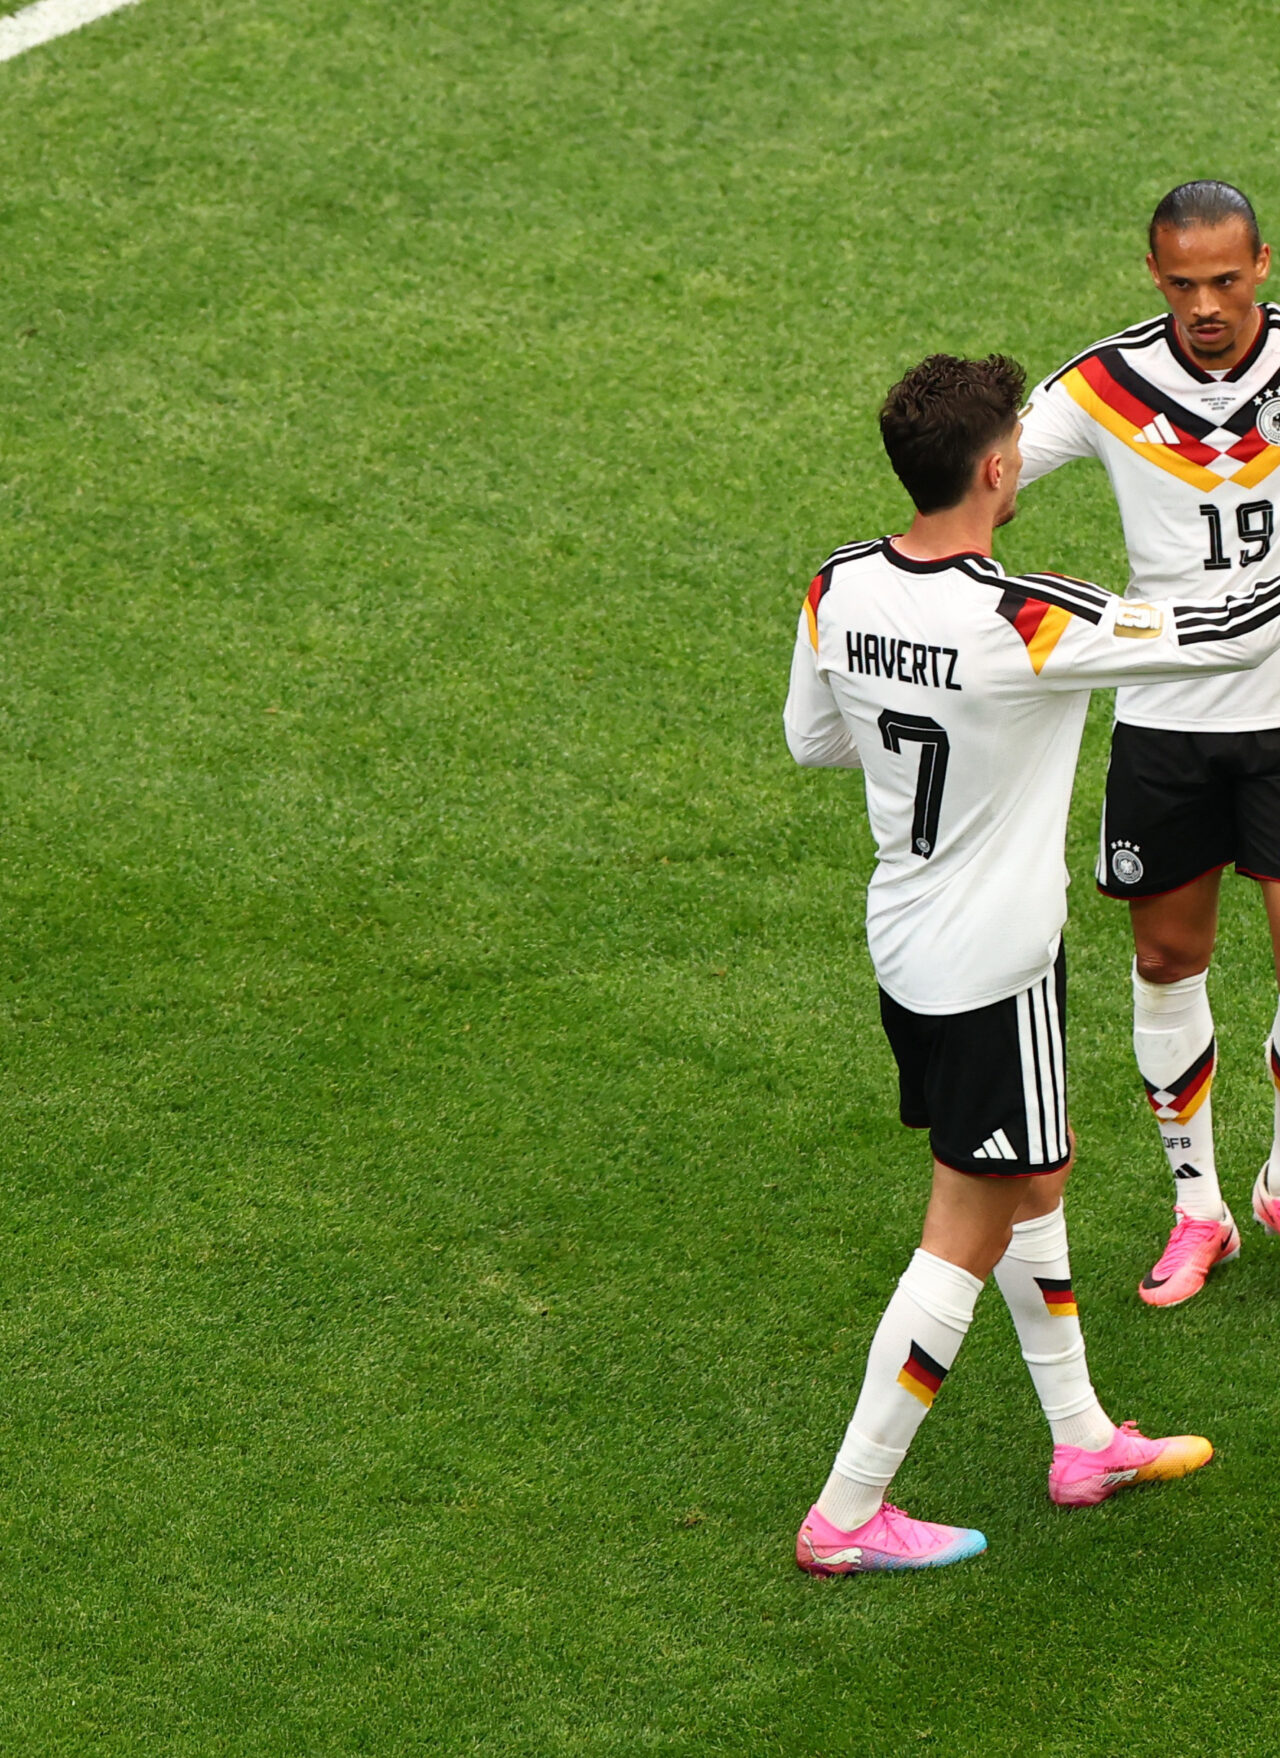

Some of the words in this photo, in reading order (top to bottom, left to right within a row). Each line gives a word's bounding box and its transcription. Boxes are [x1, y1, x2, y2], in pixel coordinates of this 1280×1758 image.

[1199, 499, 1274, 570] 19
[846, 630, 962, 691] HAVERTZ
[877, 708, 950, 860] 7
[1162, 1136, 1191, 1149] DFB
